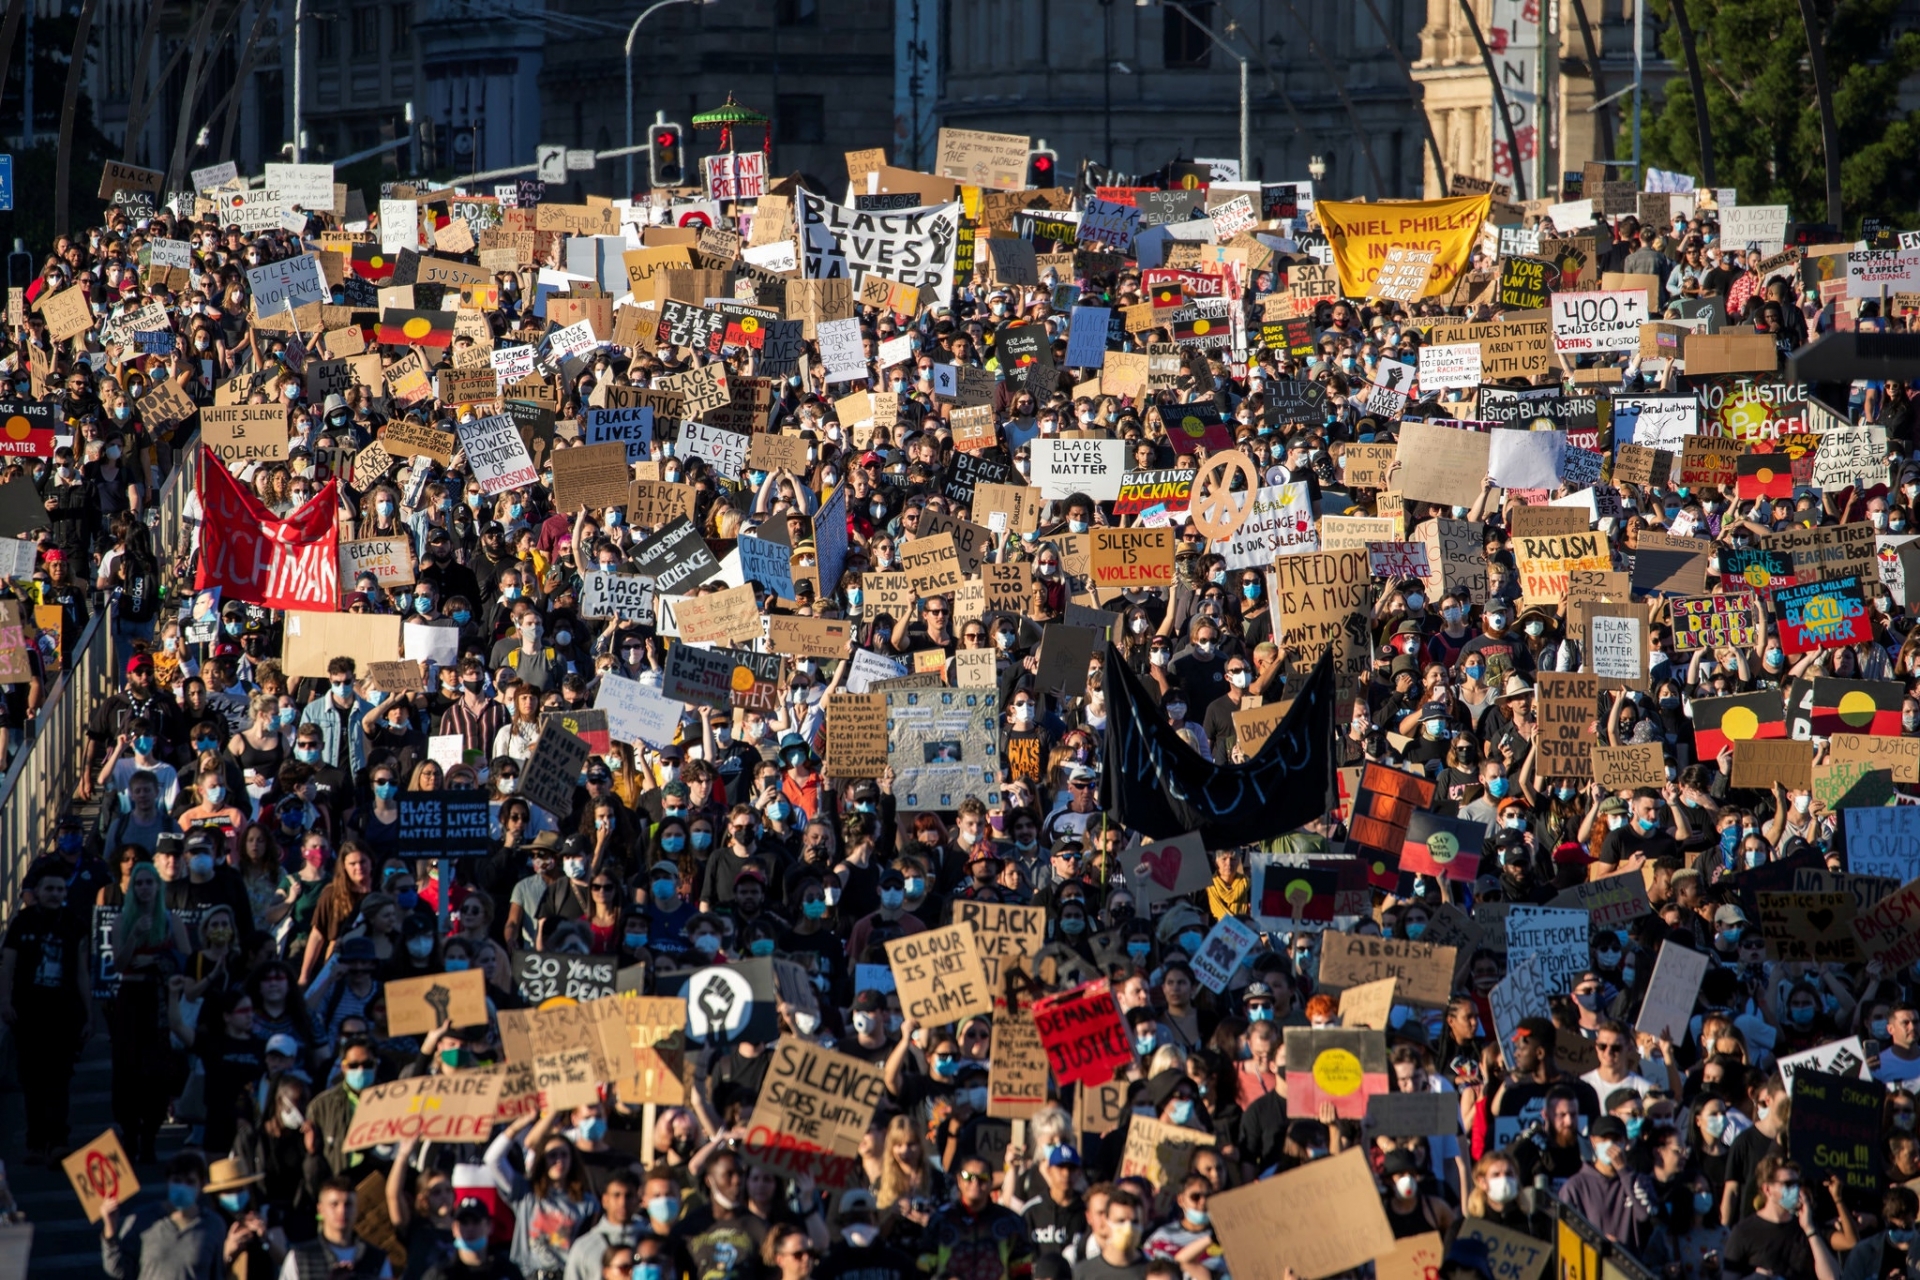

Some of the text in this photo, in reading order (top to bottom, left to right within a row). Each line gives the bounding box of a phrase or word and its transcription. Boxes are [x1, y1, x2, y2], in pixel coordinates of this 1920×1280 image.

[710, 157, 730, 176] WE
[712, 175, 763, 198] BREATHE
[114, 191, 151, 204] BLACK
[243, 189, 280, 204] JUSTICE
[245, 206, 280, 221] PEACE
[540, 209, 567, 228] STAND
[566, 215, 598, 228] BEHIND
[805, 196, 926, 235] BLACK
[1149, 213, 1190, 225] ENOUGH
[602, 220, 618, 235] YOU
[805, 228, 922, 264] LIVES
[1388, 251, 1434, 264] NO JUSTICE
[1760, 252, 1798, 272] MURDER
[1848, 250, 1899, 262] RESPECT
[1868, 256, 1919, 267] EXISTENCE
[252, 257, 316, 285] SILENCE
[1298, 266, 1327, 281] SAY
[1383, 265, 1425, 277] NO PEACE
[1511, 261, 1543, 279] YOUR
[1852, 265, 1904, 276] OR EXPECT
[1861, 272, 1911, 281] RESISTANCE
[1181, 274, 1221, 294] PRIDE
[1289, 281, 1336, 297] THEIR
[1503, 275, 1542, 288] LAW IS
[256, 278, 321, 306] VIOLENCE
[1502, 290, 1545, 308] KILLING
[1173, 305, 1229, 322] SAME STORY
[1435, 321, 1547, 342] IF ALL LIVES MATTER
[1558, 318, 1644, 335] INDIGENOUS
[1526, 340, 1547, 351] YOU
[1557, 338, 1592, 349] DEATHS
[1482, 355, 1547, 371] WITH US?
[319, 363, 358, 382] BLACK
[328, 374, 361, 388] LIVES
[503, 386, 548, 398] WHITE
[609, 387, 629, 408] NO
[1693, 381, 1808, 408] NO JUSTICE
[22, 404, 48, 416] LIVES
[204, 409, 283, 423] WHITE SILENCE
[596, 409, 641, 424] BLACK
[951, 406, 989, 418] WHITE
[1520, 400, 1596, 418] BLAK DEATHS
[460, 414, 514, 441] DISMANTLE
[963, 426, 983, 437] IS
[1732, 409, 1808, 440] PEACE!
[594, 425, 642, 441] LIVES
[1843, 432, 1873, 444] HEAR
[0, 442, 36, 453] MATTER
[466, 432, 516, 451] POWER
[763, 436, 795, 449] BLACK
[954, 437, 995, 450] VIOLENCE
[1053, 440, 1101, 452] BLACK
[1689, 436, 1744, 449] FIGHTING
[472, 444, 525, 468] STRUCTURES
[766, 447, 794, 458] LIVES
[1053, 453, 1102, 464] LIVES
[1346, 445, 1392, 458] MY SKIN
[1864, 446, 1884, 457] SEE
[492, 463, 506, 476] OF
[760, 456, 798, 471] MATTER
[1051, 464, 1108, 474] MATTER
[1378, 460, 1387, 469] IS
[482, 467, 537, 495] OPPRESSION
[1122, 470, 1194, 485] BLACK LIVES
[1352, 470, 1374, 482] NOT
[1682, 471, 1709, 484] SINCE
[637, 485, 686, 502] BLACK
[1119, 482, 1190, 501] FUCKING
[642, 501, 686, 515] LIVES
[1236, 516, 1296, 535] VIOLENCE
[1098, 533, 1165, 549] SILENCE
[1233, 528, 1315, 555] IS OUR SILENCE
[1371, 542, 1419, 554] SILENCE
[1527, 537, 1598, 559] RACISM
[350, 544, 393, 560] BLACK
[904, 546, 957, 569] JUSTICE
[1122, 549, 1137, 563] IS
[1098, 564, 1172, 581] VIOLENCE
[1280, 550, 1370, 588] FREEDOM
[1376, 563, 1431, 577] SENTENCE
[595, 576, 652, 592] BLACK
[866, 577, 885, 589] WE
[912, 572, 958, 590] PEACE
[992, 582, 1022, 593] TOO
[132, 577, 144, 614] adidas
[600, 592, 642, 605] LIVES
[880, 591, 898, 602] DO
[990, 594, 1032, 612] MANY
[1282, 583, 1371, 613] IS A MUST
[593, 604, 652, 619] MATTER
[1673, 597, 1712, 617] STOP
[1786, 599, 1863, 627] BLACK LIVES
[1594, 620, 1630, 631] #BLAK
[1688, 612, 1747, 631] DEATHS
[1321, 621, 1342, 639] NO
[1596, 633, 1632, 643] LIVES
[1676, 626, 1754, 648] IN CUSTODY
[1799, 620, 1856, 644] MATTER
[1595, 645, 1633, 656] MATTER
[958, 653, 994, 667] SILENCE
[969, 668, 980, 679] IS
[1540, 680, 1597, 698] WE ARE
[1559, 726, 1580, 739] ON
[1597, 748, 1651, 761] THINGS
[1609, 759, 1650, 772] MUST
[1603, 769, 1662, 785] CHANGE
[401, 801, 441, 814] BLACK
[401, 814, 442, 825] LIVES
[963, 904, 1038, 934] BLACK
[1508, 929, 1588, 947] WHITE PEOPLE
[894, 932, 962, 963] COLOUR
[1347, 940, 1433, 958] ABOLISH
[523, 955, 612, 980] 30 YEARS
[903, 950, 964, 982] IS NOT
[931, 977, 946, 990] A
[909, 984, 977, 1018] CRIME
[1040, 999, 1116, 1034] DEMAND
[1049, 1025, 1131, 1073] JUSTICE
[776, 1046, 884, 1107] SILENCE
[368, 1077, 492, 1105] NO PRIDE
[993, 1082, 1043, 1096] POLICE
[767, 1083, 863, 1128] SIDES WITH
[347, 1115, 494, 1145] GENOCIDE
[787, 1112, 820, 1138] THE
